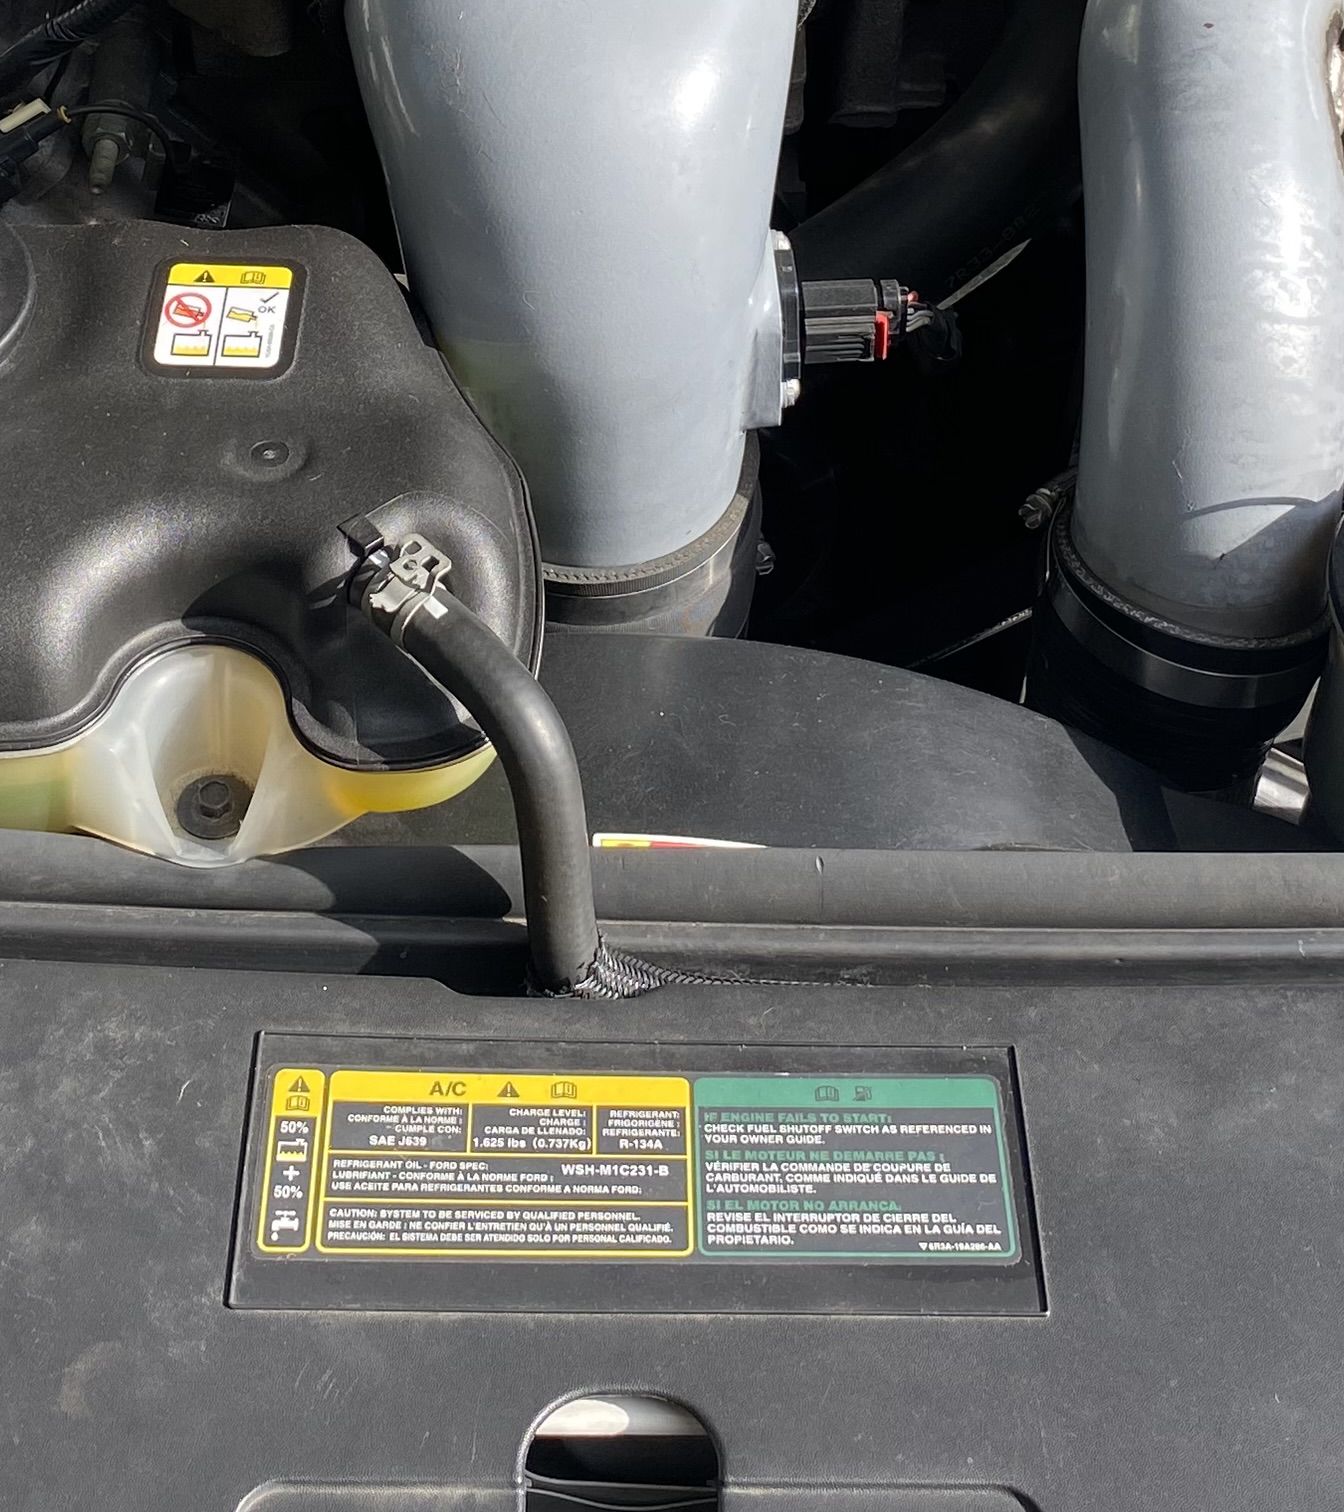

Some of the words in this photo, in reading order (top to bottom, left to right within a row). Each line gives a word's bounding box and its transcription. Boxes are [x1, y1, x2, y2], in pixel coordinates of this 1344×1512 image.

[258, 306, 276, 314] OK
[429, 1081, 466, 1096] A/C
[384, 1106, 433, 1115] COMPLIES
[436, 1107, 463, 1116] WITH:
[509, 1108, 550, 1117] CHARGE
[552, 1109, 586, 1118] LEVEL:
[348, 1114, 399, 1123] CONFORME
[410, 1115, 422, 1124] LA
[423, 1116, 457, 1125] NORME
[539, 1118, 579, 1127] CHARGE
[720, 1112, 774, 1123] ENGINE
[777, 1112, 817, 1123] FAILS
[820, 1113, 839, 1123] TO
[280, 1121, 309, 1134] 50%
[395, 1125, 435, 1134] CUMPLE
[484, 1126, 519, 1135] CARGA
[521, 1126, 535, 1135] DE
[704, 1123, 745, 1134] CHECK
[747, 1124, 777, 1134] FUEL
[779, 1124, 832, 1134] SHUTOFF
[834, 1124, 880, 1134] SWITCH
[881, 1124, 898, 1134] AS
[900, 1124, 978, 1135] REFERENCED
[979, 1124, 992, 1134] IN
[369, 1135, 395, 1146] SAE
[398, 1136, 427, 1147] J639
[473, 1137, 505, 1148] 1.625
[508, 1138, 526, 1148] lbs
[532, 1138, 592, 1151] (0.737Kg)
[619, 1139, 663, 1150] R-134A
[704, 1134, 738, 1144] YOUR
[740, 1134, 784, 1144] OWNER
[705, 1150, 719, 1160] SI
[723, 1150, 741, 1160] LE
[744, 1150, 806, 1161] MOTEUR
[809, 1150, 830, 1161] NE
[907, 1151, 935, 1162] PAS
[333, 1159, 403, 1169] REFRIGERANT
[405, 1160, 422, 1169] OIL
[429, 1161, 457, 1170] FORD
[561, 1164, 669, 1177] WSH-M1C231-B
[705, 1160, 760, 1172] VÉRIFIER
[763, 1162, 779, 1172] LA
[780, 1162, 851, 1172] COMMANDE
[853, 1162, 870, 1172] DE
[872, 1162, 931, 1172] COUPURE
[934, 1162, 951, 1172] DE
[332, 1171, 391, 1181] LUBRIFIANT
[398, 1172, 455, 1181] CONFORME
[467, 1173, 480, 1182] LA
[481, 1173, 518, 1182] NORME
[520, 1174, 547, 1183] FORD
[785, 1173, 831, 1183] COMME
[833, 1171, 883, 1184] INDIQUÉ
[885, 1173, 919, 1183] DANS
[921, 1174, 937, 1183] LE
[939, 1174, 977, 1183] GUIDE
[979, 1174, 997, 1183] DE
[273, 1185, 303, 1199] 50%
[331, 1182, 352, 1191] USE
[353, 1182, 389, 1192] ACEITE
[391, 1182, 419, 1192] PARA
[420, 1183, 503, 1193] REFRIGERANTES
[505, 1184, 562, 1194] CONFORME
[573, 1185, 610, 1194] NORMA
[706, 1200, 721, 1210] SI
[724, 1200, 744, 1210] EL
[747, 1200, 800, 1211] MOTOR
[803, 1200, 824, 1211] NO
[329, 1208, 377, 1218] CAUTION:
[379, 1209, 420, 1219] SYSTEM
[422, 1210, 437, 1219] TO
[438, 1210, 453, 1219] BE
[454, 1210, 504, 1220] SERVICED
[506, 1211, 521, 1220] BY
[523, 1211, 576, 1221] QUALIFIED
[707, 1212, 752, 1222] REVISE
[754, 1212, 771, 1222] EL
[773, 1212, 860, 1223] INTERRUPTOR
[863, 1213, 881, 1223] DE
[883, 1213, 929, 1223] CIERRE
[932, 1213, 957, 1223] DEL
[328, 1220, 352, 1229] MISE
[353, 1220, 367, 1229] EN
[368, 1220, 402, 1230] GARDE
[409, 1221, 424, 1230] NE
[425, 1221, 466, 1231] CONFIER
[467, 1222, 527, 1231] L'ENTRETIEN
[554, 1223, 568, 1232] UN
[570, 1223, 627, 1233] PERSONNEL
[707, 1223, 796, 1234] COMBUSTIBLE
[799, 1224, 837, 1234] COMO
[840, 1224, 856, 1234] SE
[859, 1224, 901, 1234] INDICA
[904, 1224, 922, 1234] EN
[924, 1224, 941, 1234] LA
[943, 1222, 974, 1234] GUÍA
[976, 1224, 1001, 1234] DEL
[389, 1232, 400, 1241] EL
[402, 1232, 438, 1242] SISTEMA
[439, 1233, 463, 1242] DEBE
[465, 1233, 482, 1242] SER
[483, 1233, 526, 1243] ATENDIDO
[527, 1234, 551, 1243] SOLO
[552, 1234, 571, 1243] POR
[572, 1234, 617, 1244] PERSONAL
[707, 1235, 794, 1245] PROPIETARIO.
